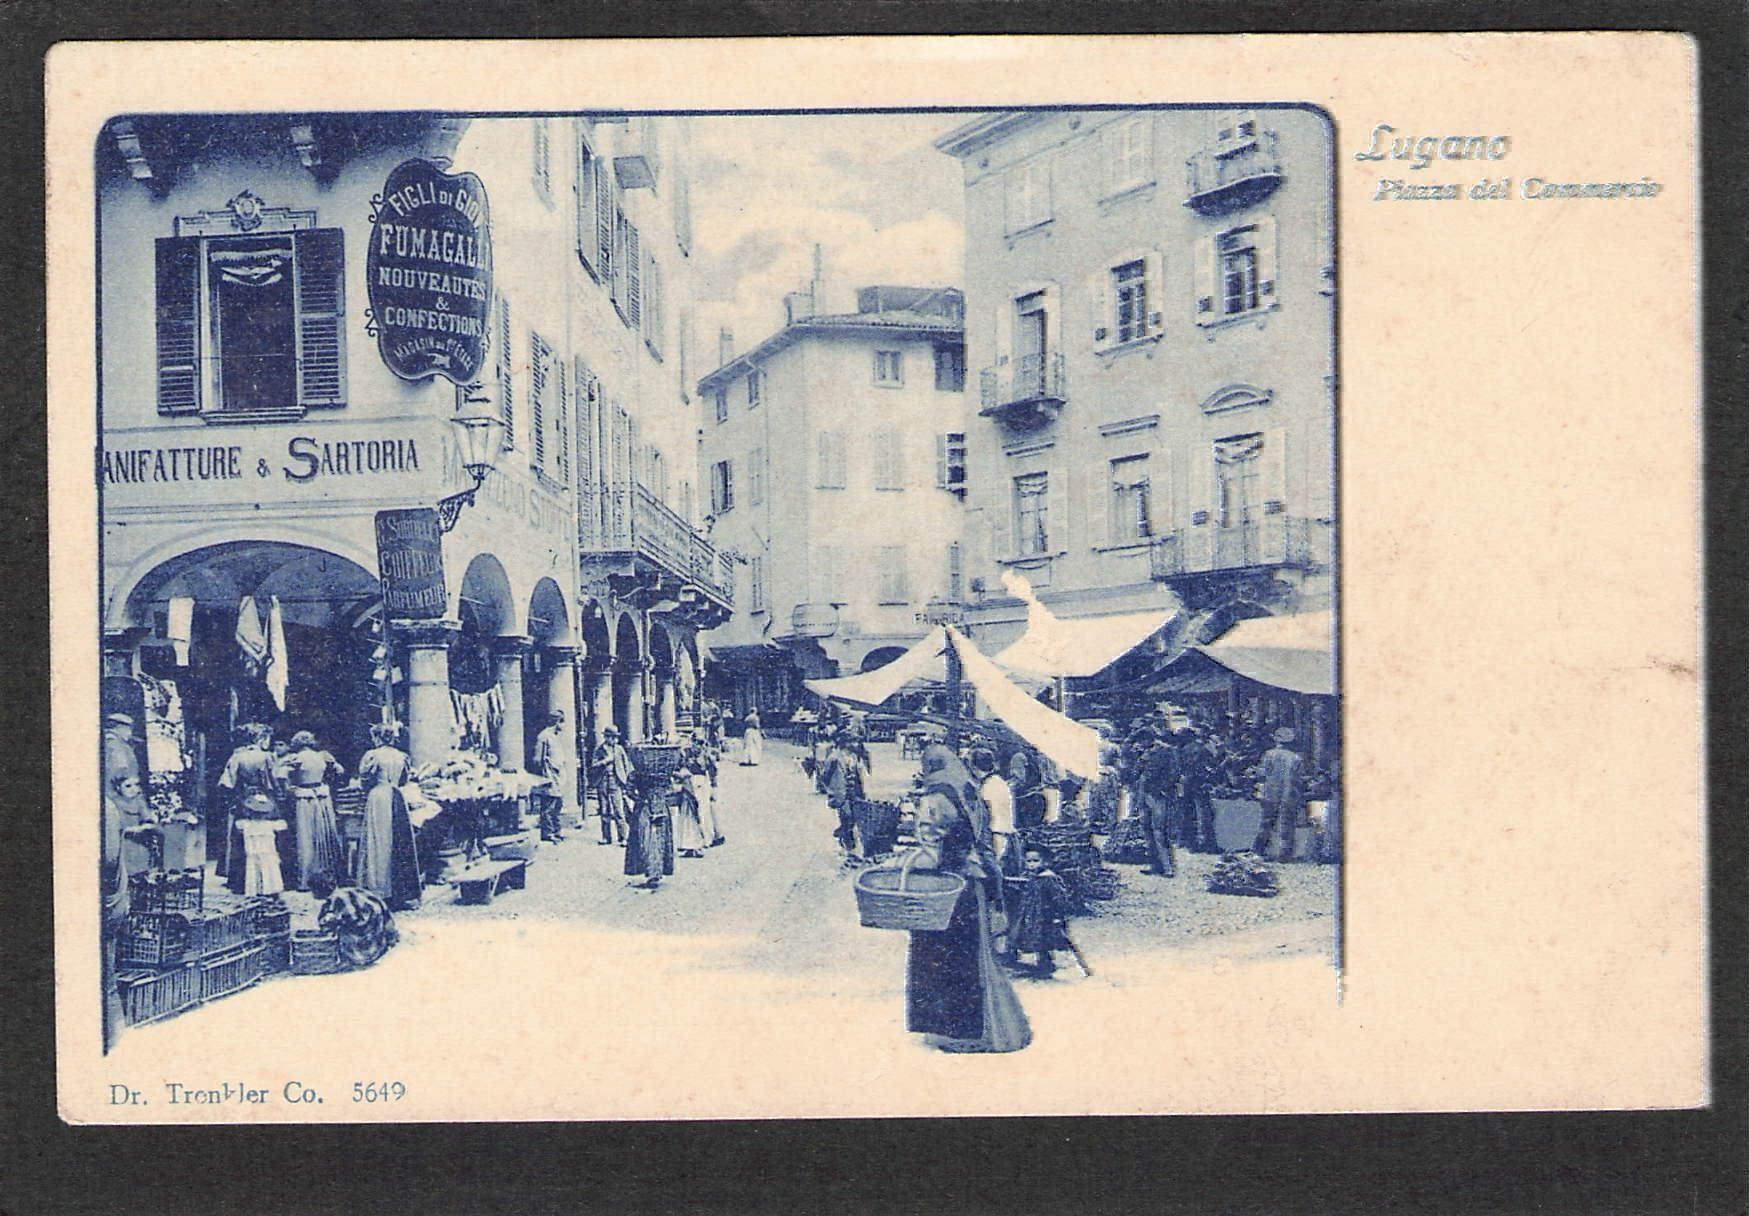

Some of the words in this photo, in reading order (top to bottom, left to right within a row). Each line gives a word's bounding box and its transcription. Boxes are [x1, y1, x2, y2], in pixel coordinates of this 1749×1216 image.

[388, 181, 436, 217] FIGLI
[439, 191, 452, 206] DI
[435, 296, 450, 311] &
[385, 307, 484, 337] CONFECTIONS
[256, 457, 271, 478] &
[282, 437, 420, 484] SARTORIA
